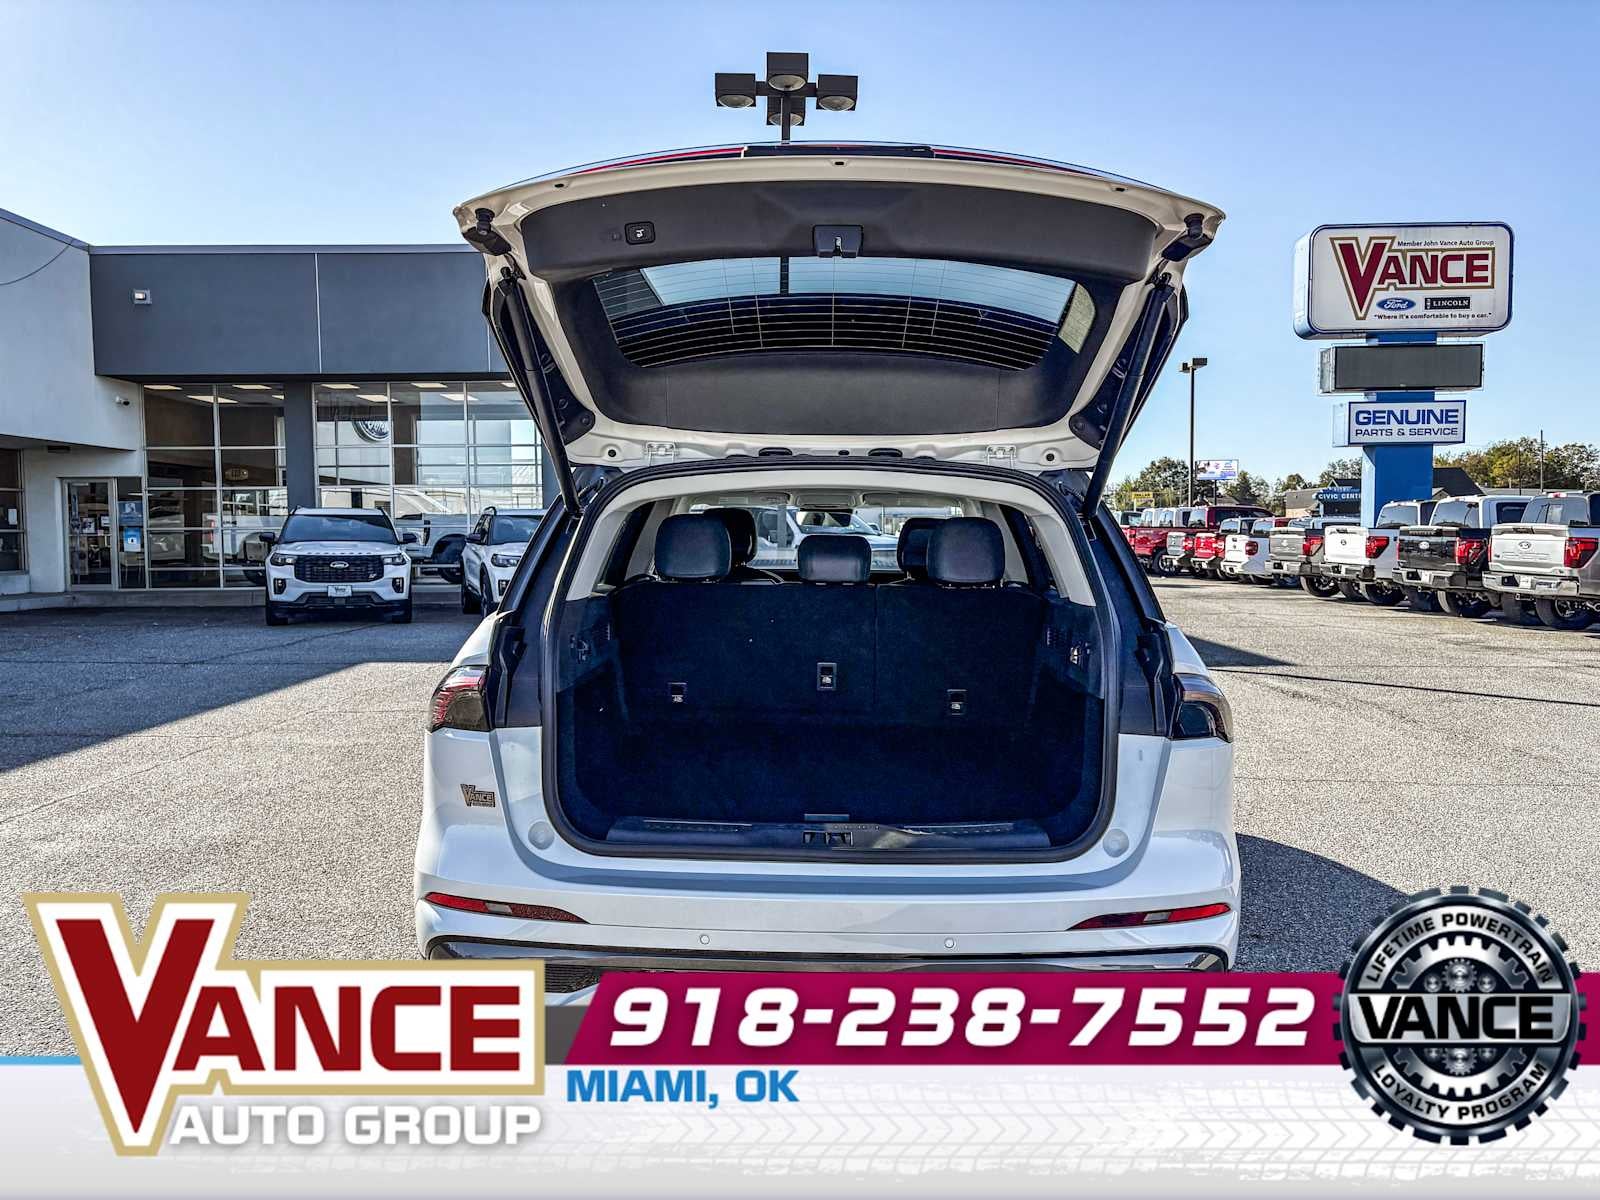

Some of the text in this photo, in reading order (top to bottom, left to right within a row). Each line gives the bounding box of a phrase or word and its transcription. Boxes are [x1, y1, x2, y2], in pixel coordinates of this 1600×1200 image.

[1338, 242, 1489, 314] VANCE
[1383, 299, 1409, 309] Ford
[1433, 299, 1469, 307] LINCOLN
[1355, 409, 1459, 425] GENUINE
[1355, 427, 1458, 437] PARTS & SERVICE
[461, 785, 494, 806] VANCE
